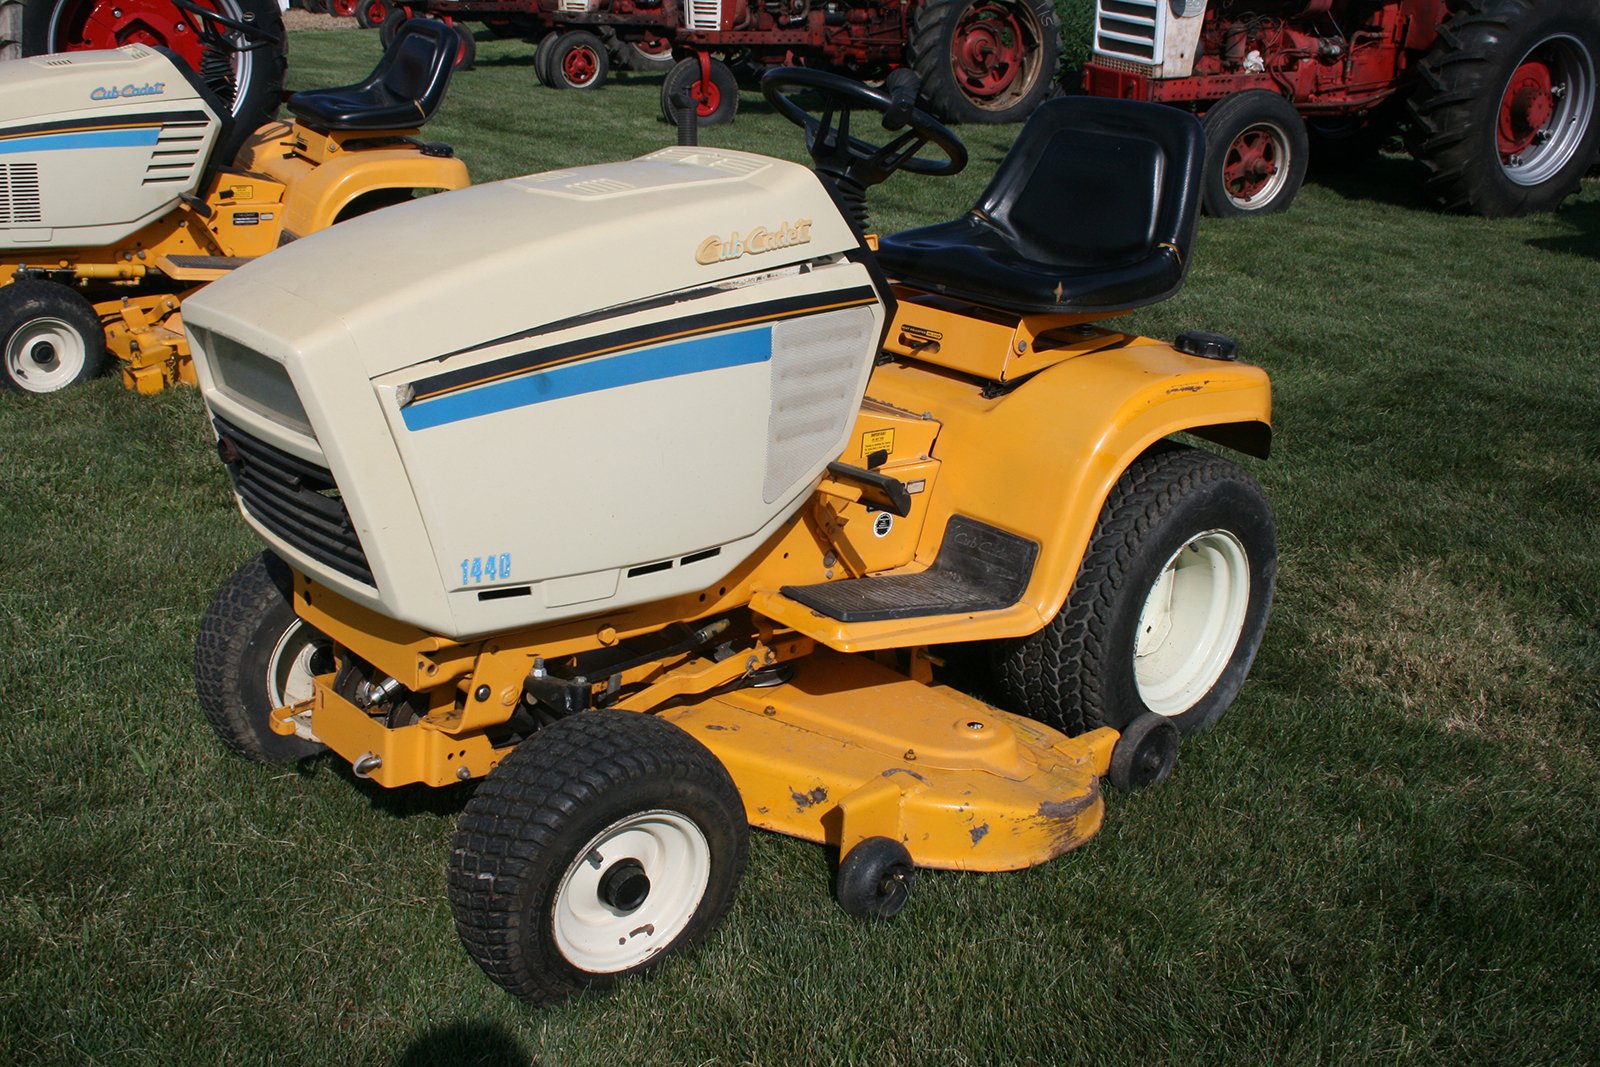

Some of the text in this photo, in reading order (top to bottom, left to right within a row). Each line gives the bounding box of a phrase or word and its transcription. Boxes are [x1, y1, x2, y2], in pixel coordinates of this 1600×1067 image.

[90, 82, 166, 101] Cub Cadet
[695, 218, 812, 265] Cub Cadet
[461, 552, 511, 585] 1440
